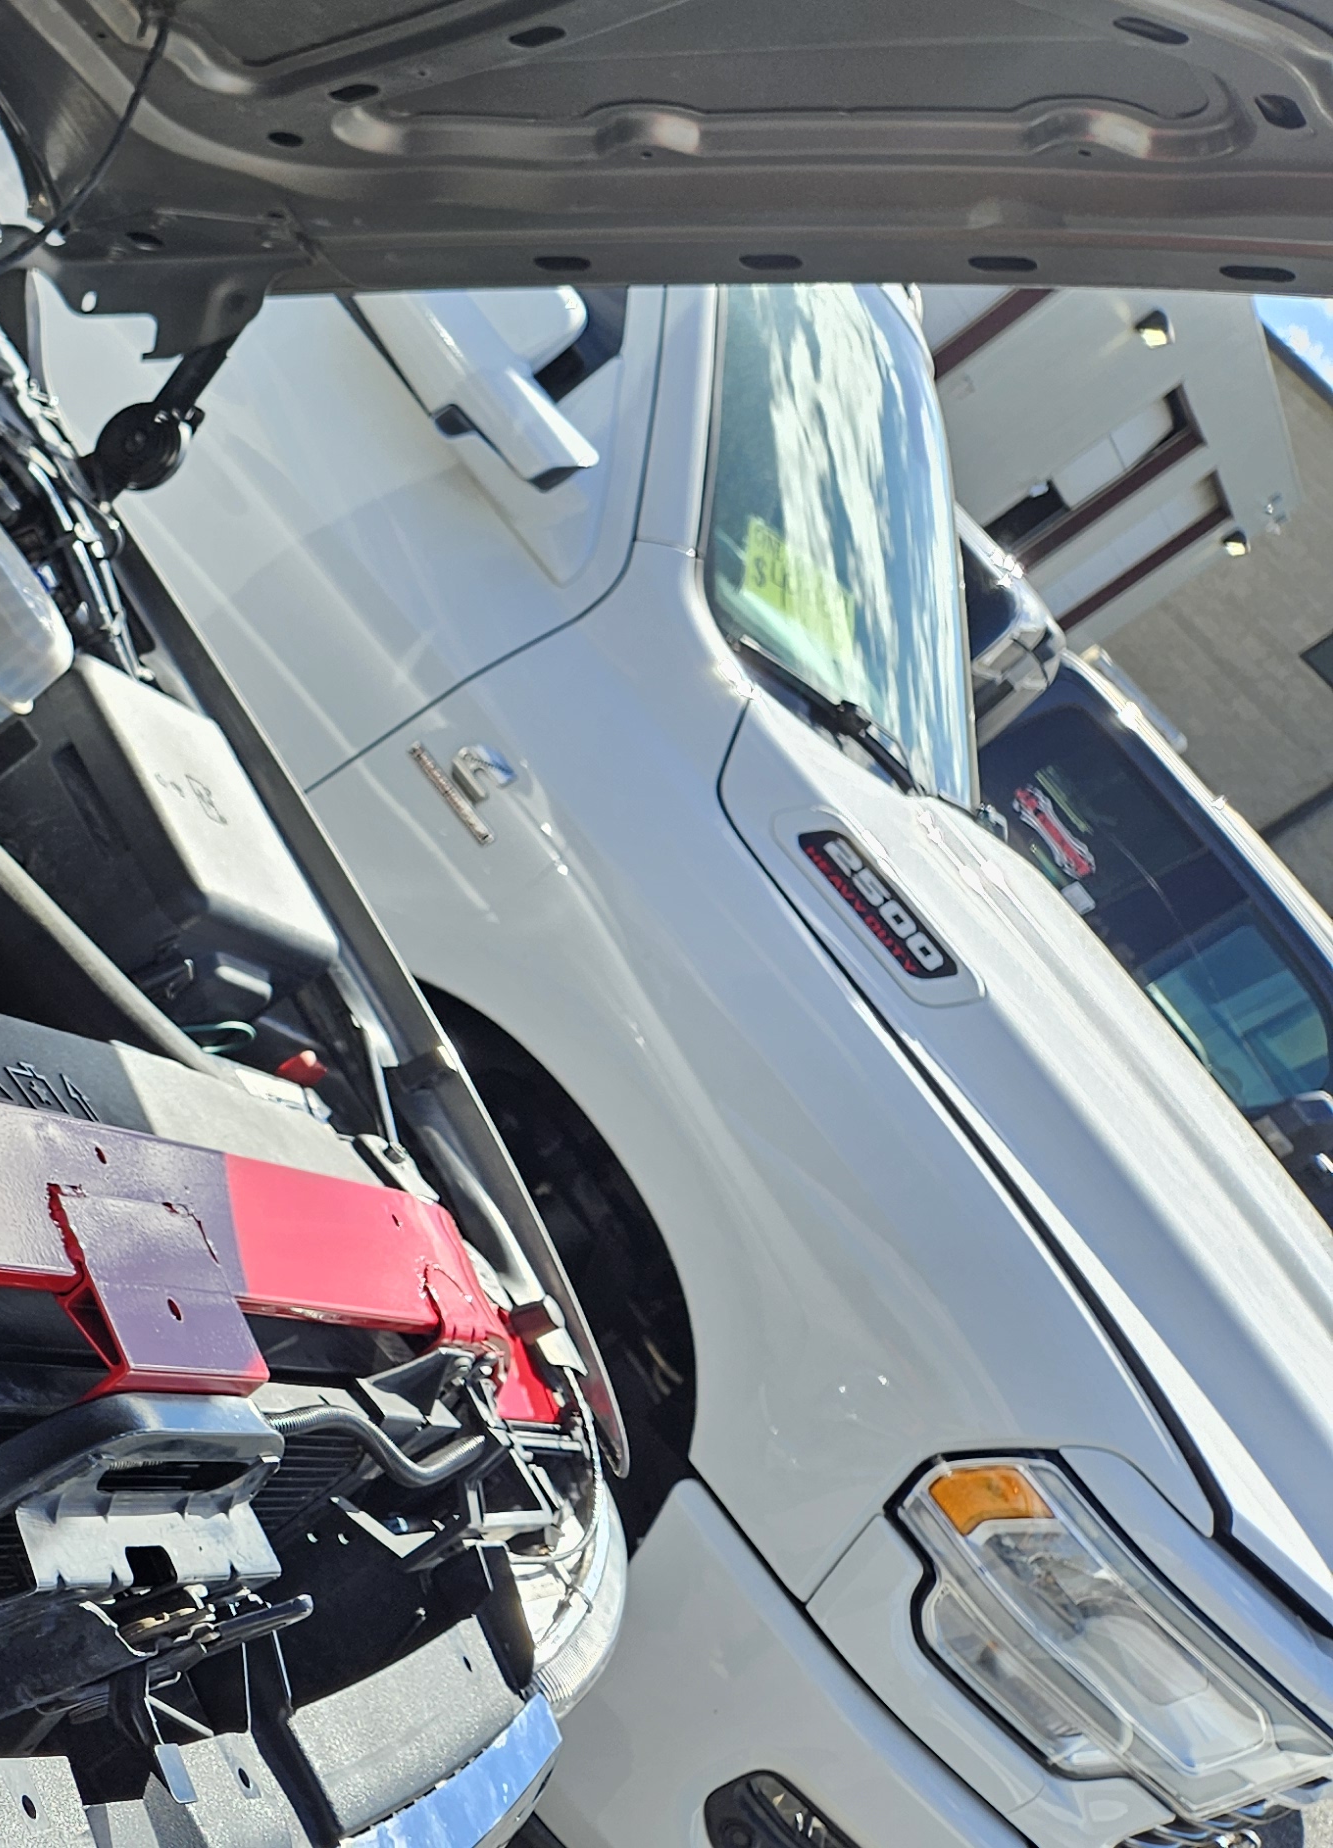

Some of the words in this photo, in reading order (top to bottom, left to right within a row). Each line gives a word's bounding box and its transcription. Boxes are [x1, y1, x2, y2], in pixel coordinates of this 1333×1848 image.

[804, 845, 868, 913] HEAVY
[864, 915, 918, 974] DUTY
[823, 837, 945, 972] 2500
